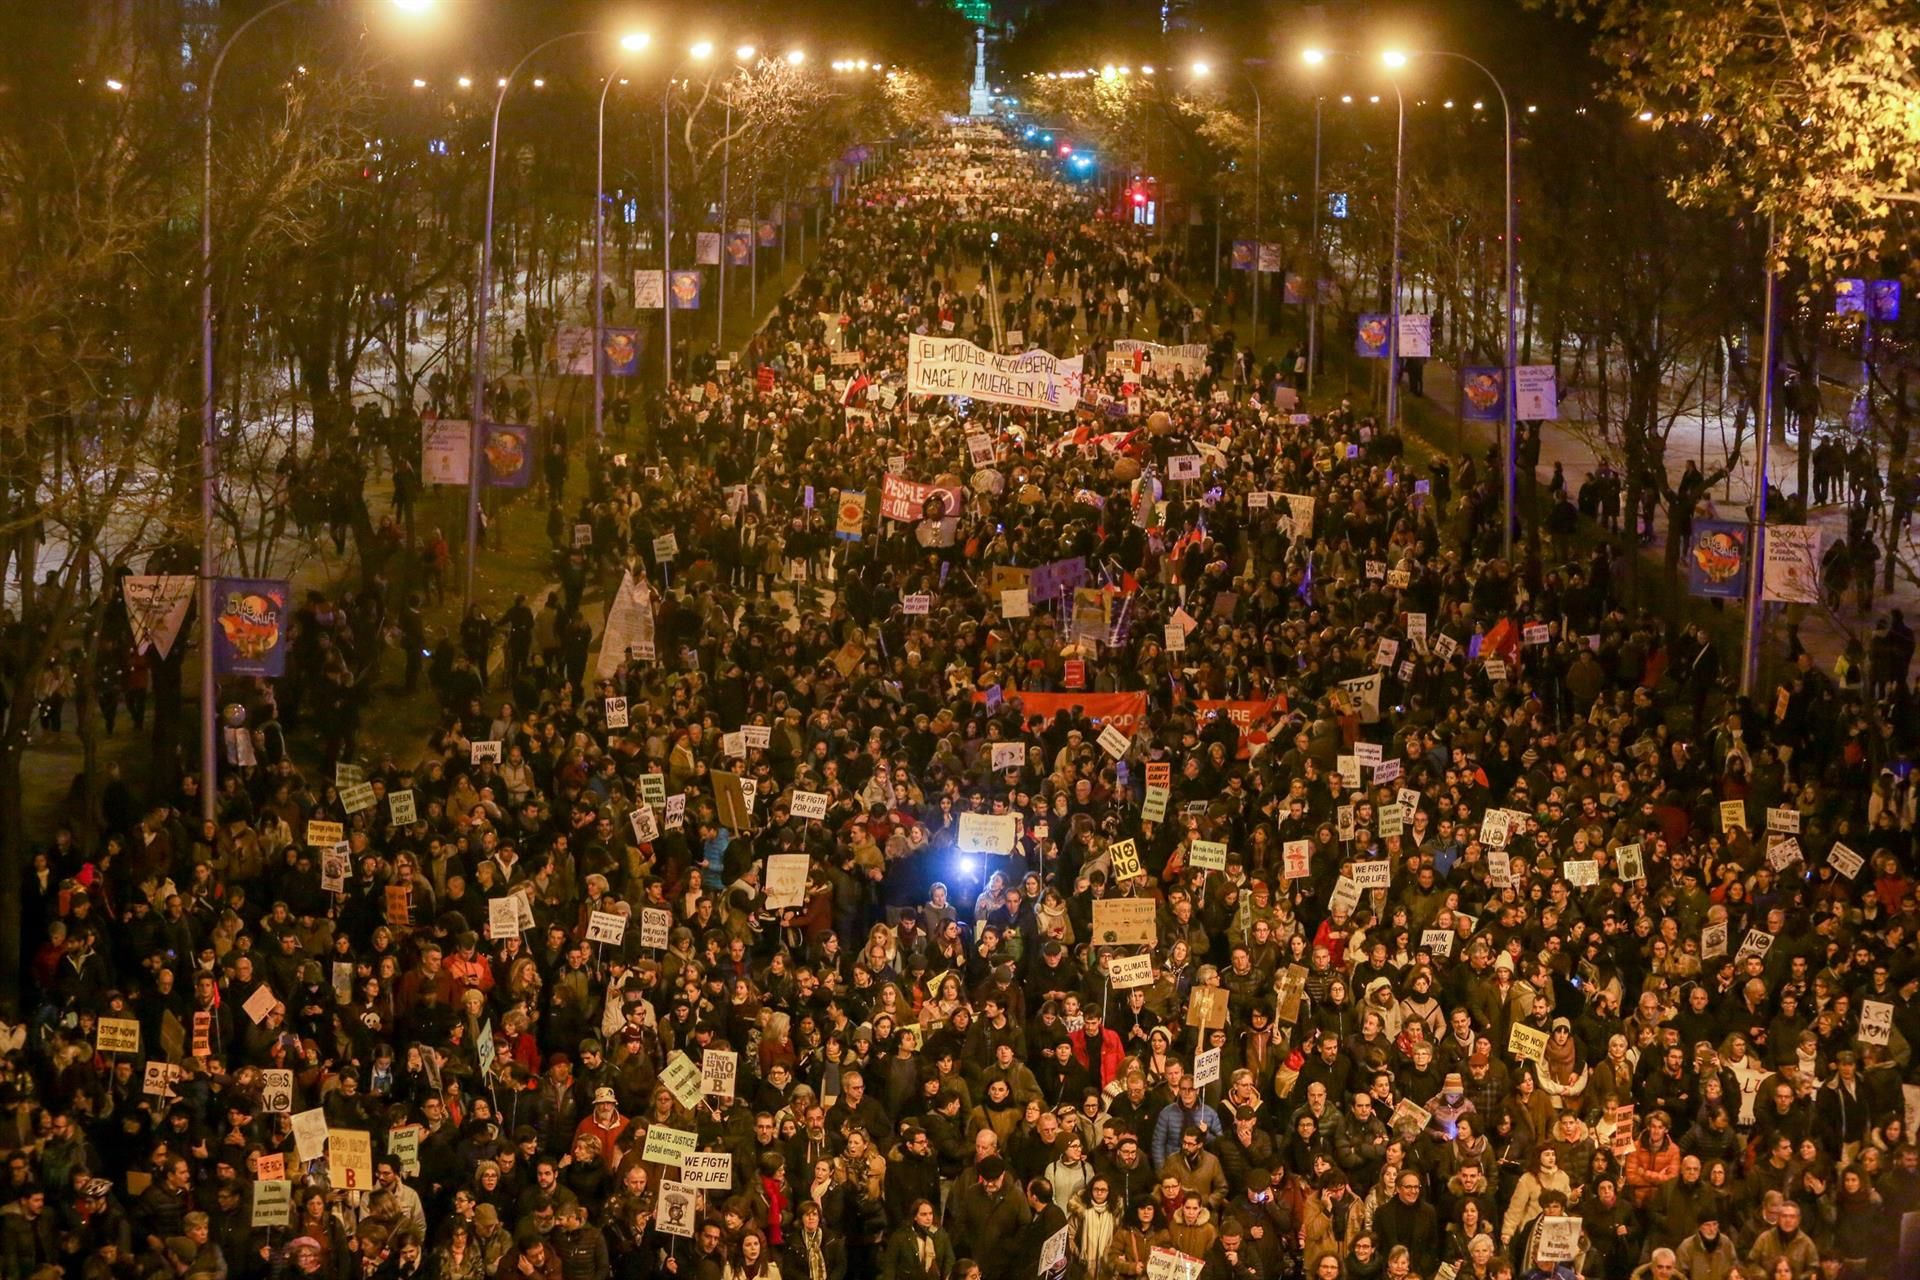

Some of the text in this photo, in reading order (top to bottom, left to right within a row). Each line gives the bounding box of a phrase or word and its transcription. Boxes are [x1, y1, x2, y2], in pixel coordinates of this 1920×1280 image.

[922, 368, 957, 388] NACE
[961, 370, 968, 388] Y
[972, 372, 1016, 394] MUERE
[1018, 381, 1033, 398] EN
[885, 478, 924, 504] PEOPLE
[893, 501, 911, 520] OIL
[795, 793, 826, 804] WE FIGTH
[793, 803, 823, 814] FOR LIFE!
[1111, 843, 1134, 861] NO
[1115, 859, 1139, 878] NO
[1355, 864, 1388, 873] WE FIGTH
[1356, 874, 1388, 883] FOR LIFE!
[1123, 960, 1148, 972] CLIMATE
[1111, 973, 1134, 984] CHAOS,
[100, 1025, 136, 1037] STOP NOW
[1513, 1030, 1544, 1048] STOP NOW
[710, 1052, 730, 1061] There
[715, 1059, 734, 1072] NO
[704, 1069, 734, 1080] planet
[649, 1130, 672, 1142] CLIMATE
[646, 1143, 663, 1155] global
[684, 1156, 729, 1169] WE FIGTH
[346, 1168, 356, 1188] B
[684, 1170, 729, 1183] FOR LIFE!
[1150, 1255, 1171, 1270] Change
